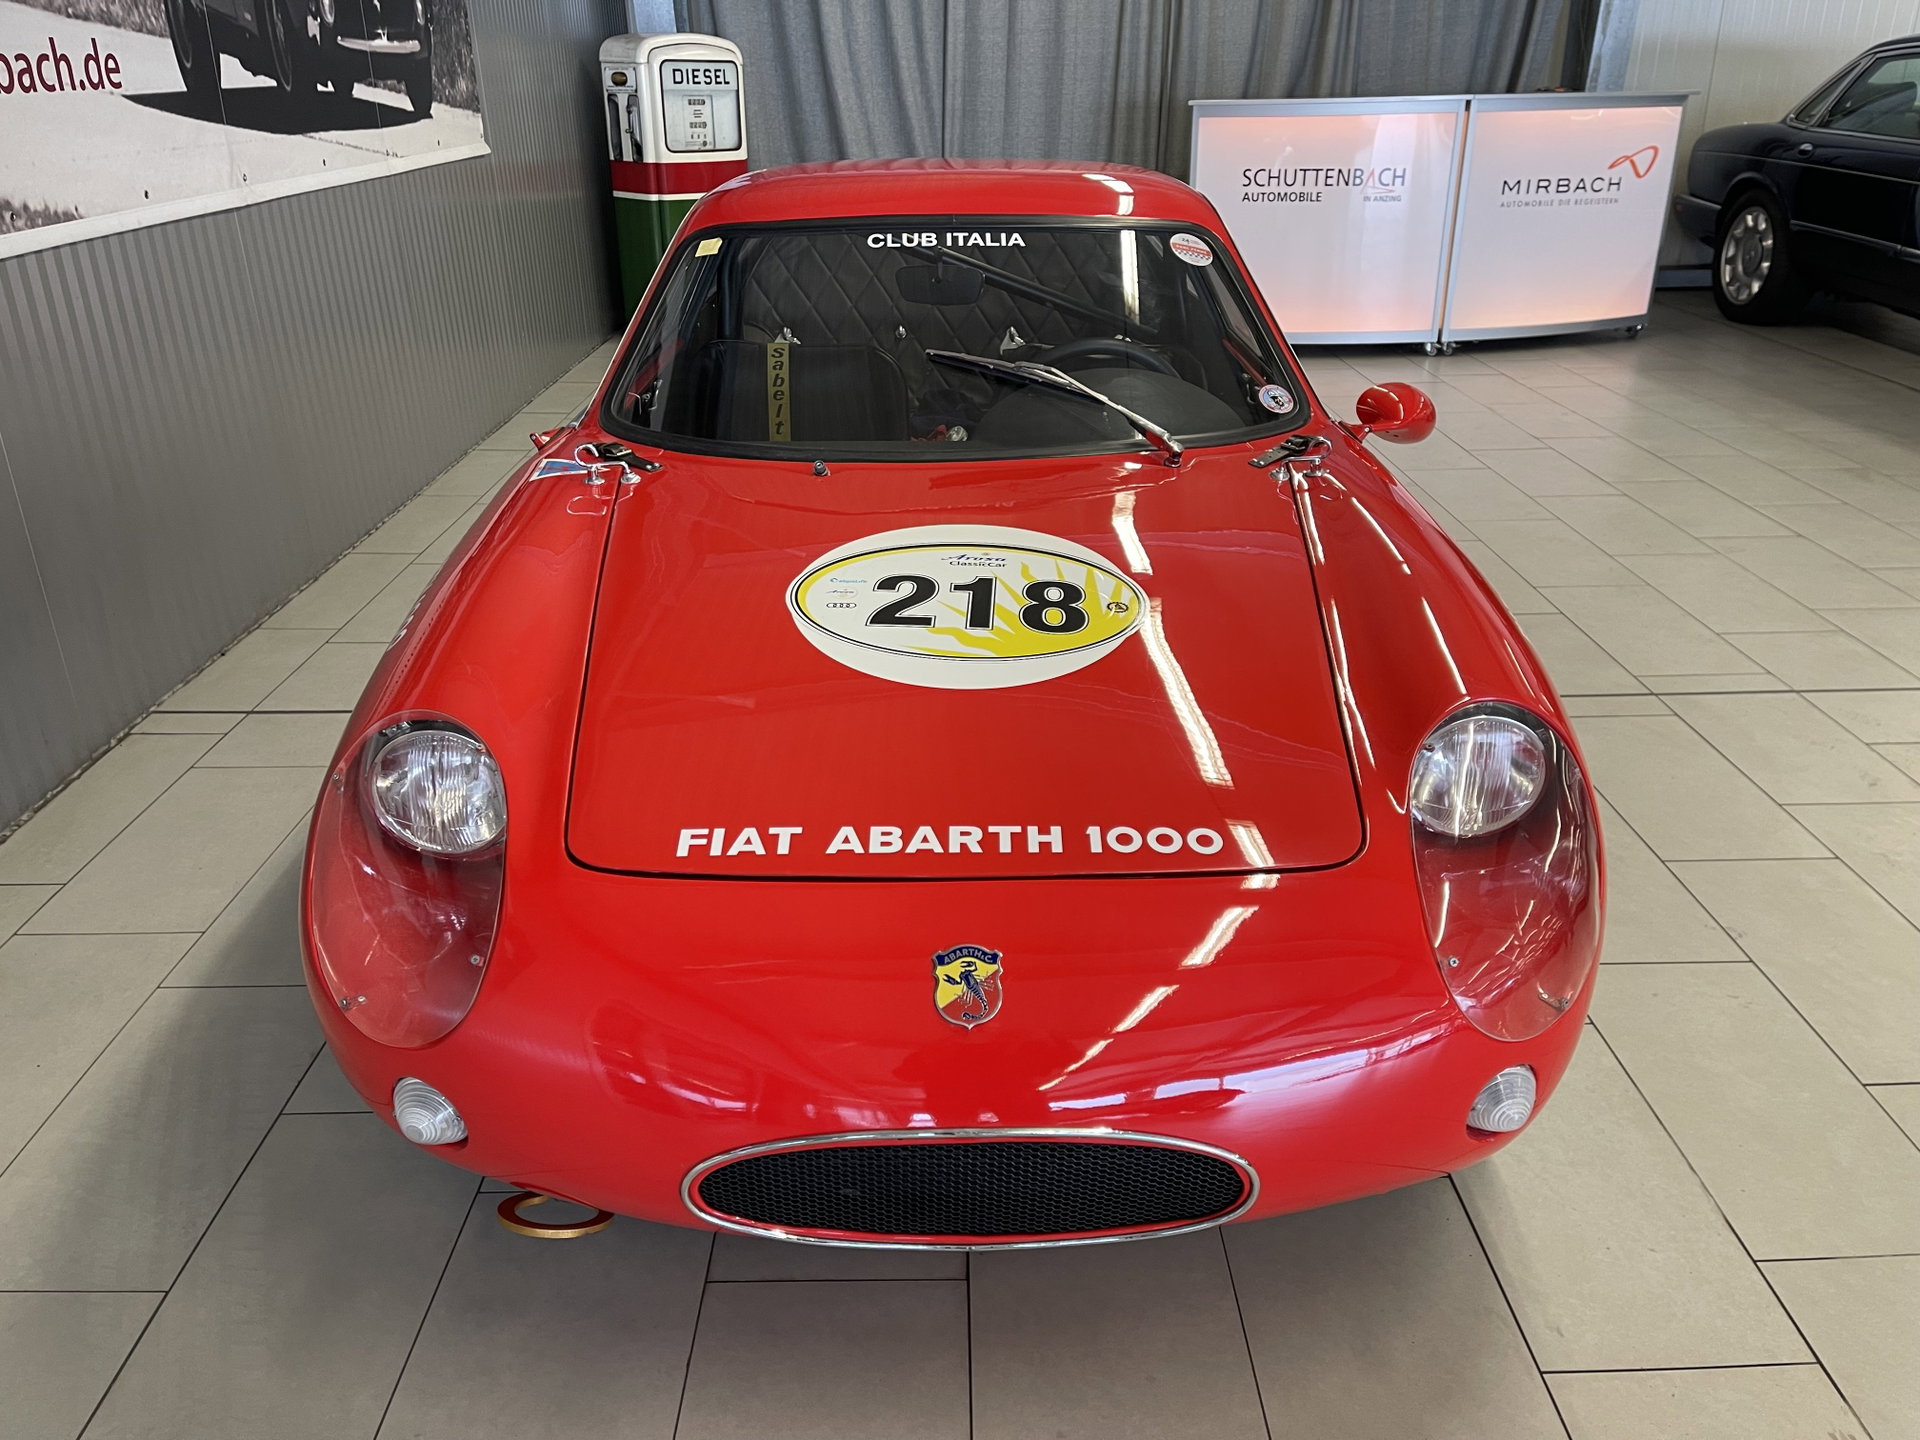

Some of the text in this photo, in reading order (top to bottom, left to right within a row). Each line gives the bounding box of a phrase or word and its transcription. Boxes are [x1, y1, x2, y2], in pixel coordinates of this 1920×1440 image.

[672, 68, 730, 85] DIESEL
[1242, 168, 1407, 188] SCHUTTENBACH
[1501, 176, 1622, 195] MIRBACH
[1242, 191, 1322, 203] AUTOMOBILE
[1500, 198, 1554, 208] AUTOMOBILE
[867, 232, 1026, 248] CLUB ITALIA
[865, 574, 1090, 635] 218
[676, 825, 1224, 857] FIAT ABARTH 1000
